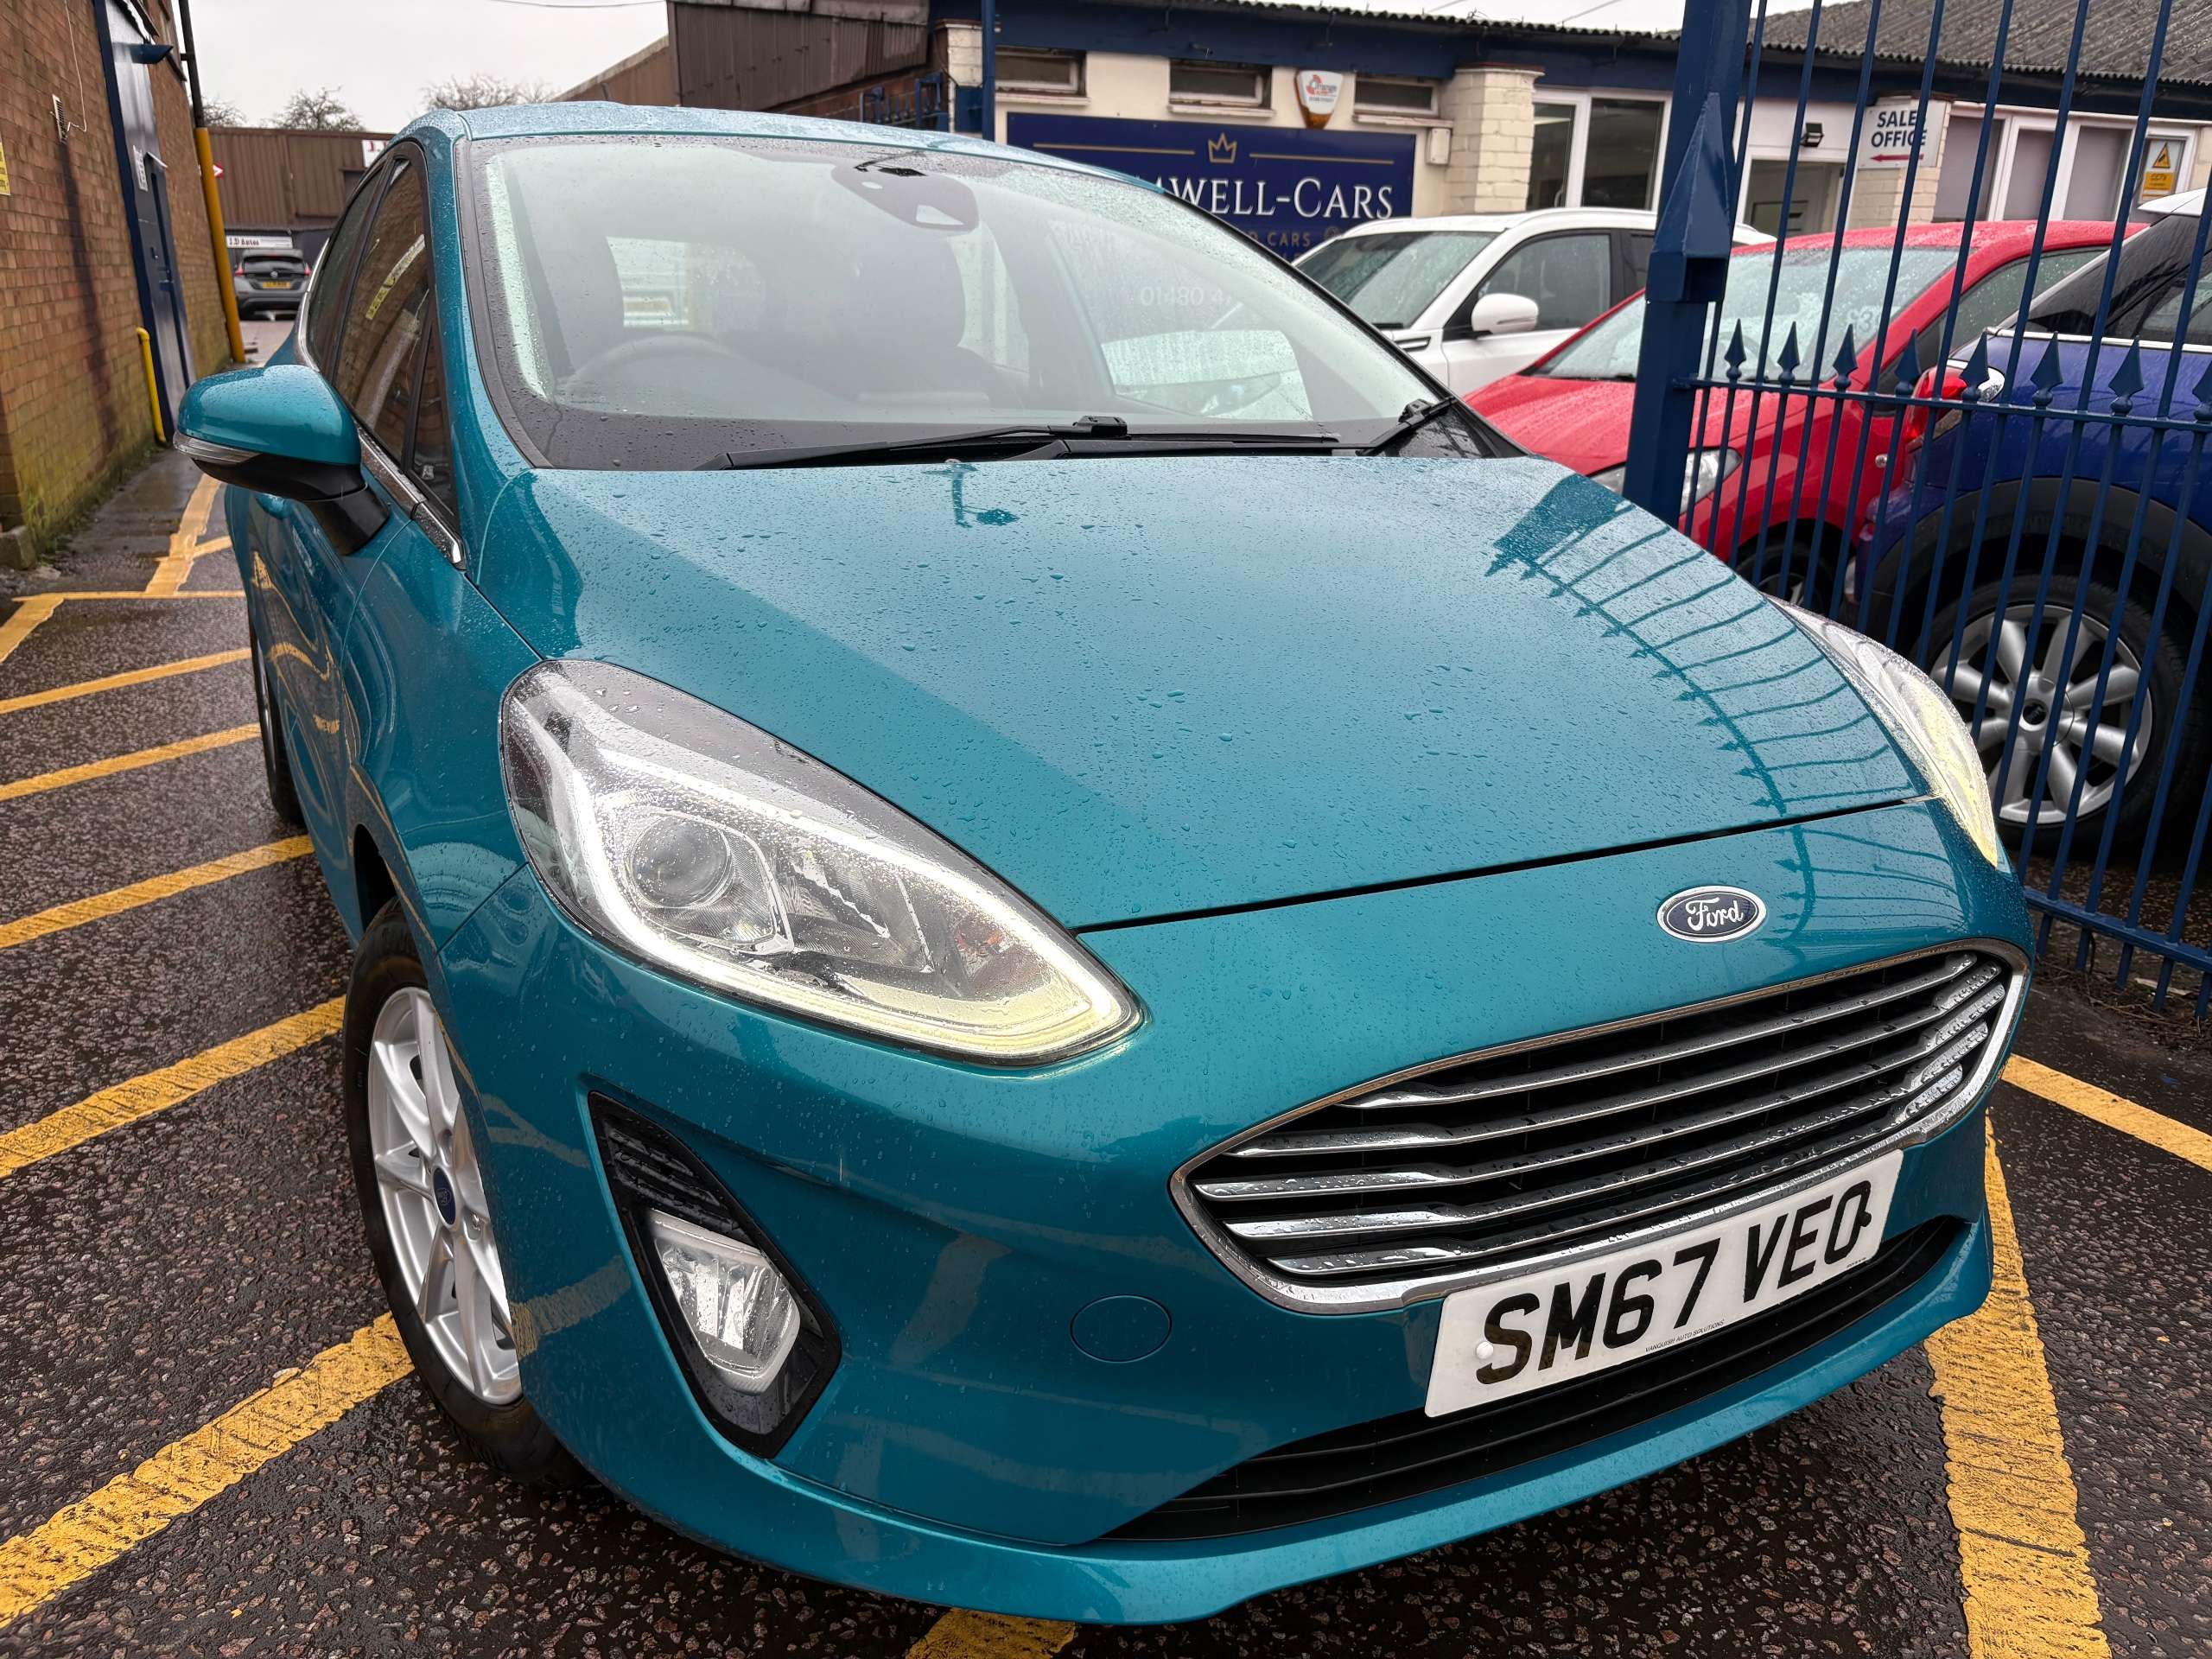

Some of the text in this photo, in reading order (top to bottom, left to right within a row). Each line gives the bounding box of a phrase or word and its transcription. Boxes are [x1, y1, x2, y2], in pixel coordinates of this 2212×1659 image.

[1877, 110, 1919, 128] SALE
[1267, 231, 1312, 247] CARS
[1140, 286, 1205, 306] 01480
[1685, 897, 1744, 931] Ford
[1476, 1180, 1872, 1385] SM67 VEO
[1645, 1338, 1675, 1352] VANQUISH
[1676, 1332, 1692, 1342] AUTO
